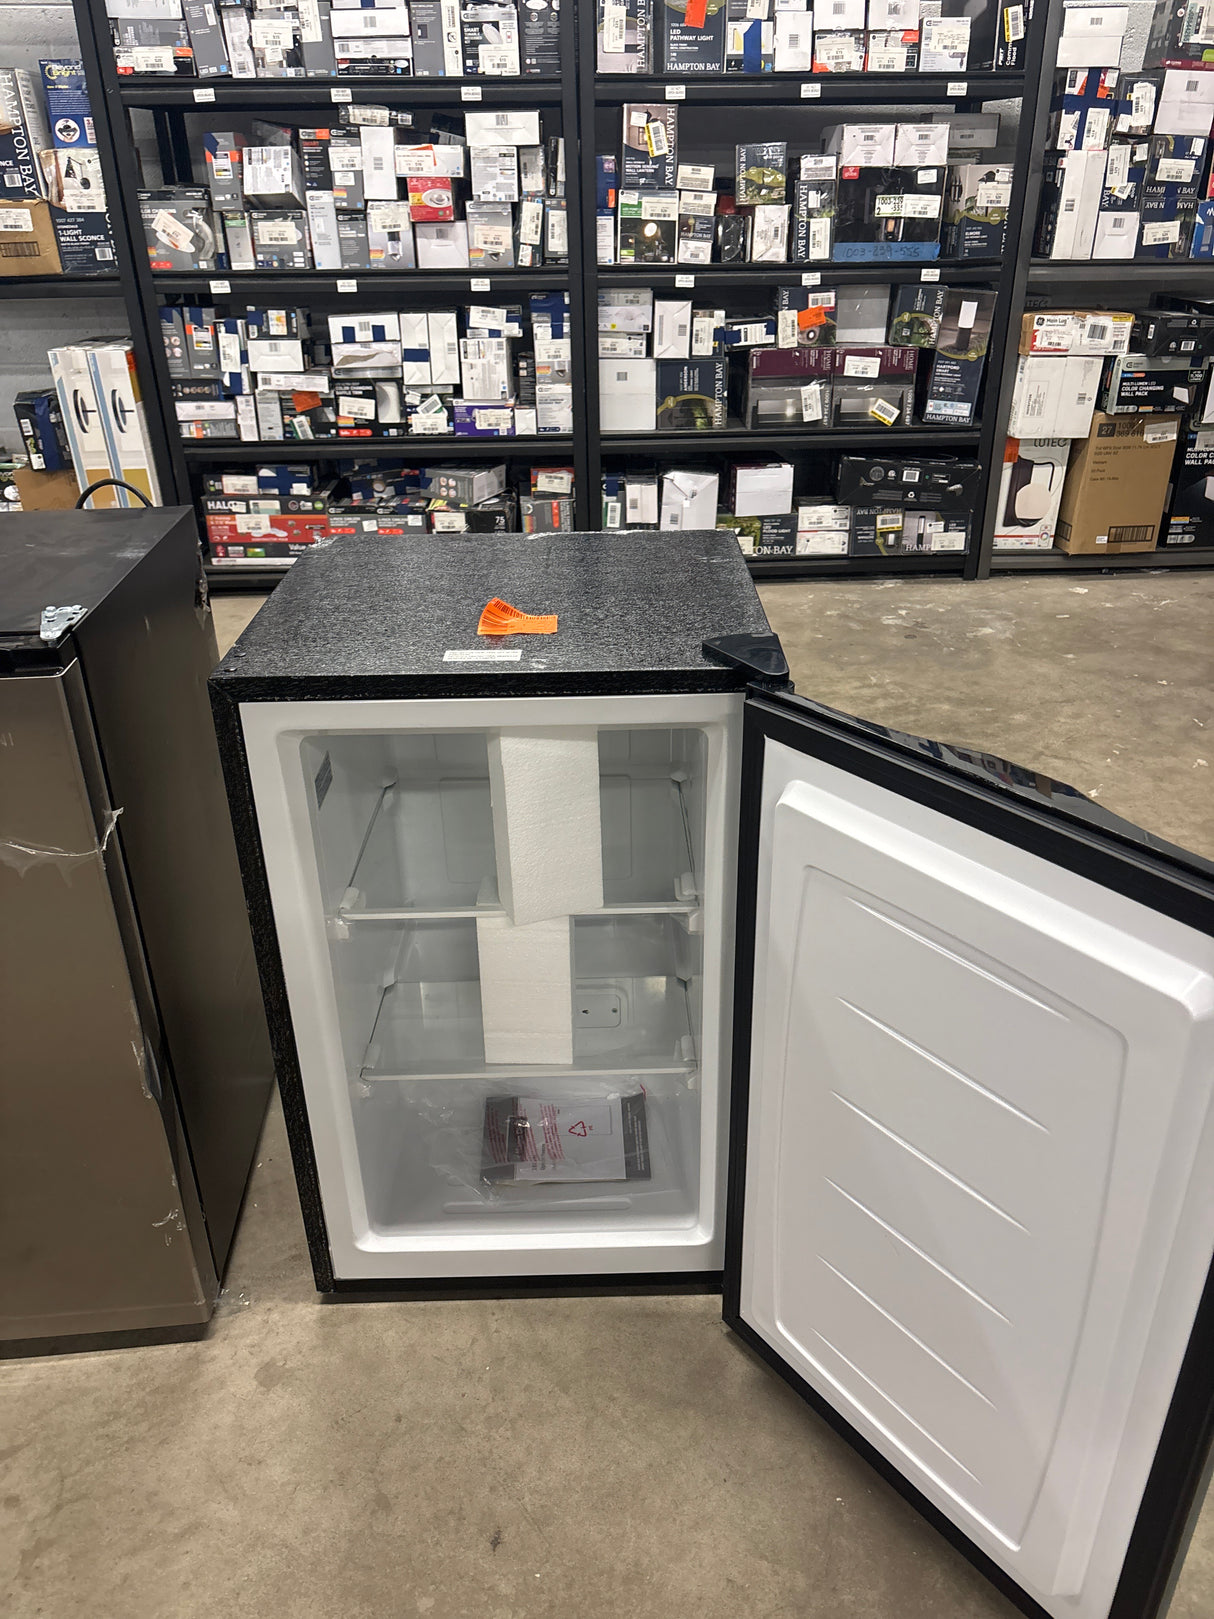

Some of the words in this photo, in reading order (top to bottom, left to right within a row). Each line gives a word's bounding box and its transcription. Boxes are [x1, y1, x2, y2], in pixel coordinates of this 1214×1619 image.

[636, 10, 647, 68] HAMPTON
[667, 62, 705, 71] HAMPTON
[706, 62, 721, 71] BAY
[0, 73, 30, 160] HAMPTON
[19, 164, 42, 198] BAY
[665, 107, 675, 163] HAMPTON
[665, 166, 674, 186] BAY
[1102, 189, 1111, 207] BAY
[799, 185, 807, 234] HAMPTON
[876, 207, 882, 216] 2
[797, 239, 807, 258] BAY
[928, 306, 942, 345] HAMPTON
[935, 289, 944, 304] BAY
[1057, 317, 1068, 325] Lug
[714, 362, 724, 379] BAY
[714, 380, 724, 426] HAMPTON
[926, 414, 958, 422] HAMPTON
[1102, 426, 1113, 435] 27
[1033, 439, 1067, 447] LUTEC
[495, 516, 505, 524] 75
[856, 508, 868, 516] BAY
[773, 546, 793, 555] BAY
